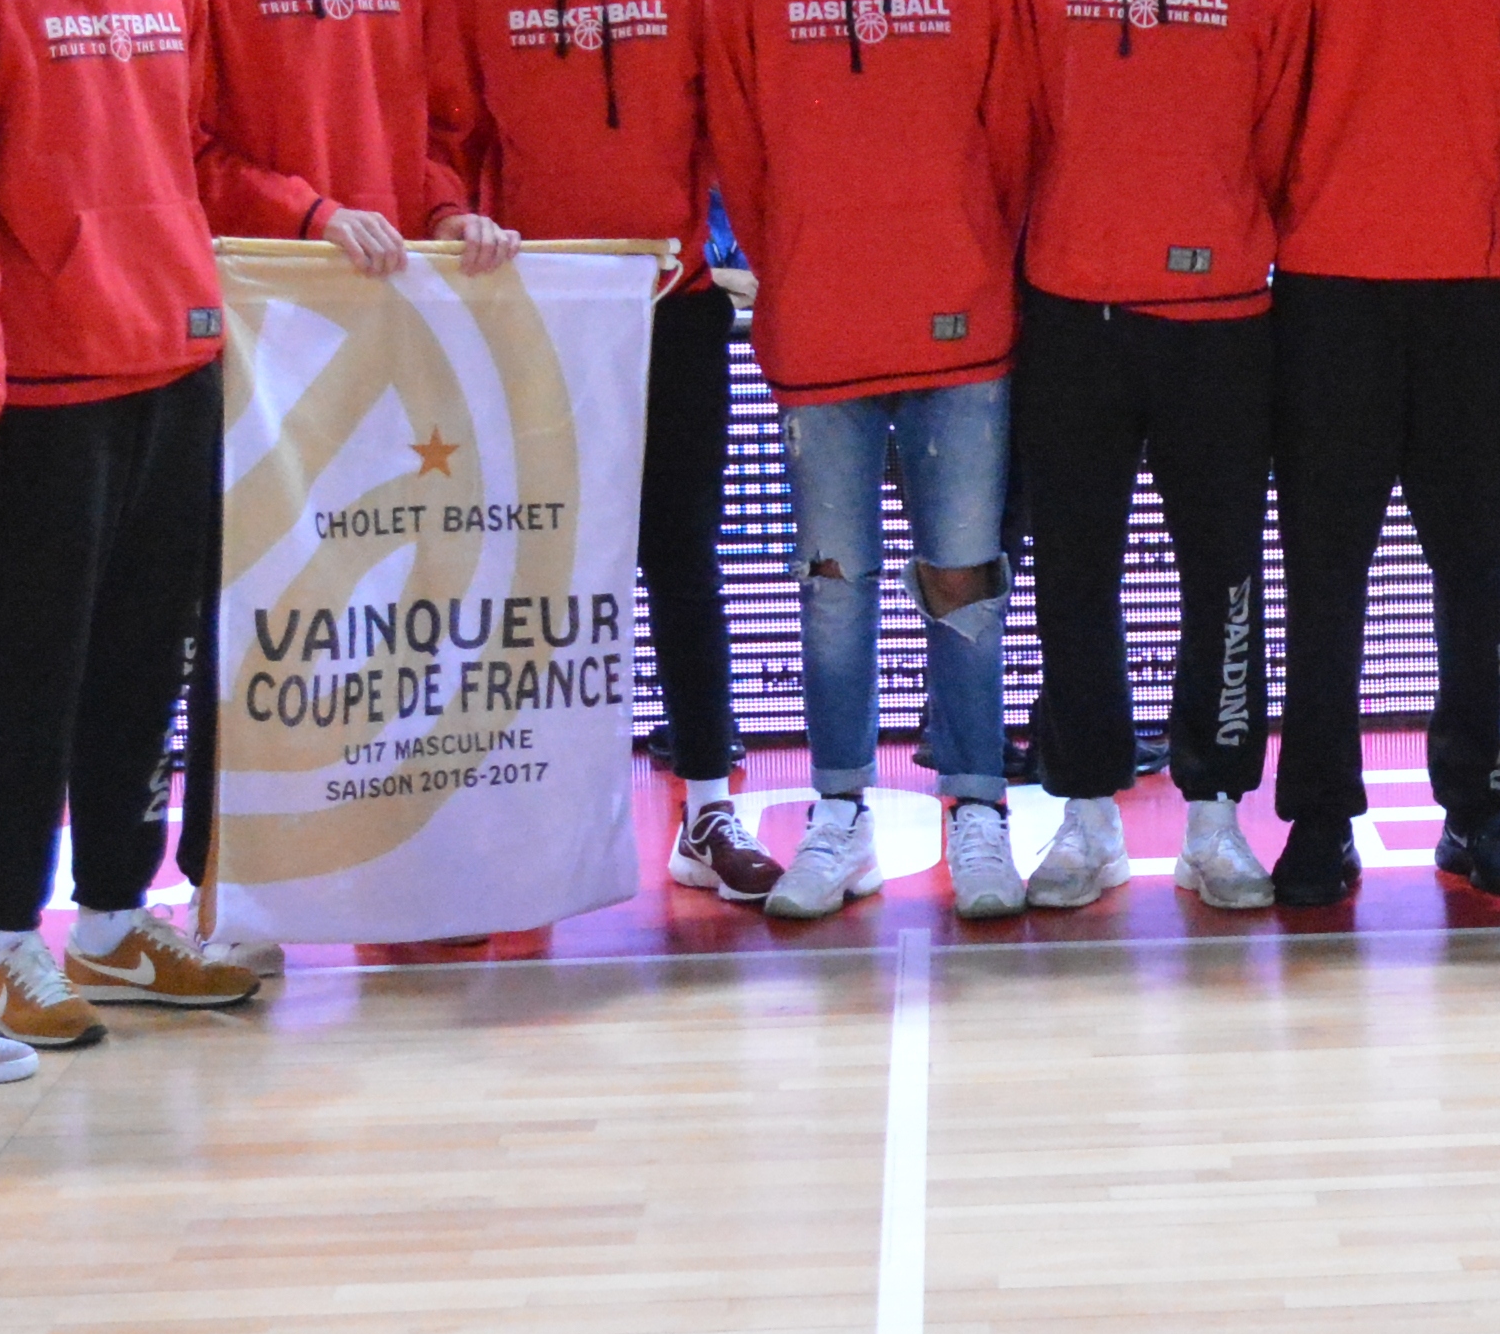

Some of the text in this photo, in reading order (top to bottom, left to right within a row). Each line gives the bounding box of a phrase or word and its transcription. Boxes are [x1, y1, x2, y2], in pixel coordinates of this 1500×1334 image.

[260, 0, 299, 15] TRUE
[1066, 4, 1228, 27] TRUE TO THE GAME
[45, 12, 182, 40] BASKETBALL
[510, 32, 546, 47] TRUE
[611, 25, 633, 39] THE
[636, 24, 668, 37] GAME
[790, 25, 826, 40] TRUE
[892, 21, 915, 34] THE
[919, 20, 951, 33] GAME
[49, 39, 185, 59] TRUE TO THE GAME
[315, 503, 566, 540] CHOLET BASKET
[254, 592, 620, 663] VAINQUEUR
[246, 653, 624, 727] COUPE DE FRANCE
[343, 729, 534, 766] U17 MASCULINE
[325, 762, 550, 802] SAISON 2016-2017
